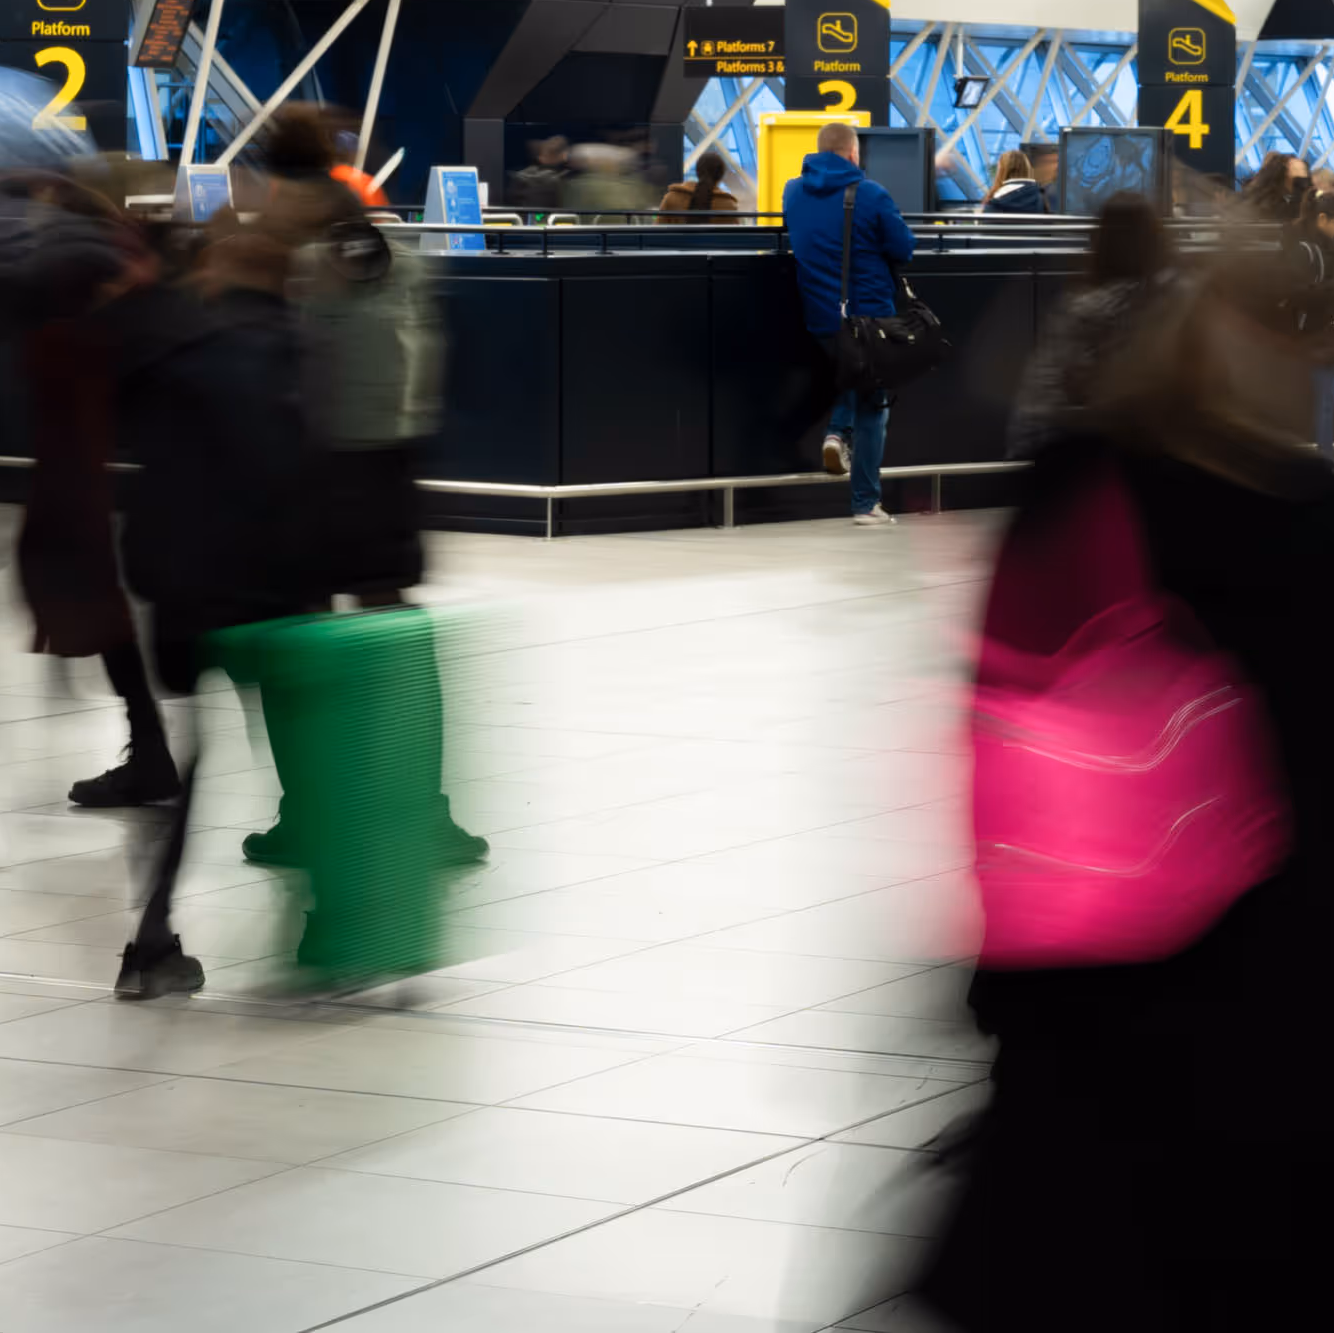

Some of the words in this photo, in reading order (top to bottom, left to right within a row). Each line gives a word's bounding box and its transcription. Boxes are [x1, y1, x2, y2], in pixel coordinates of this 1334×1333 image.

[31, 20, 91, 36] Platform
[716, 40, 766, 53] Platforms
[767, 40, 776, 52] 7
[716, 59, 766, 74] Platforms
[767, 61, 775, 73] 3
[776, 60, 785, 73] &
[813, 60, 861, 73] Platform
[1165, 71, 1209, 83] Platform
[31, 46, 87, 131] 2
[1163, 89, 1210, 149] 4
